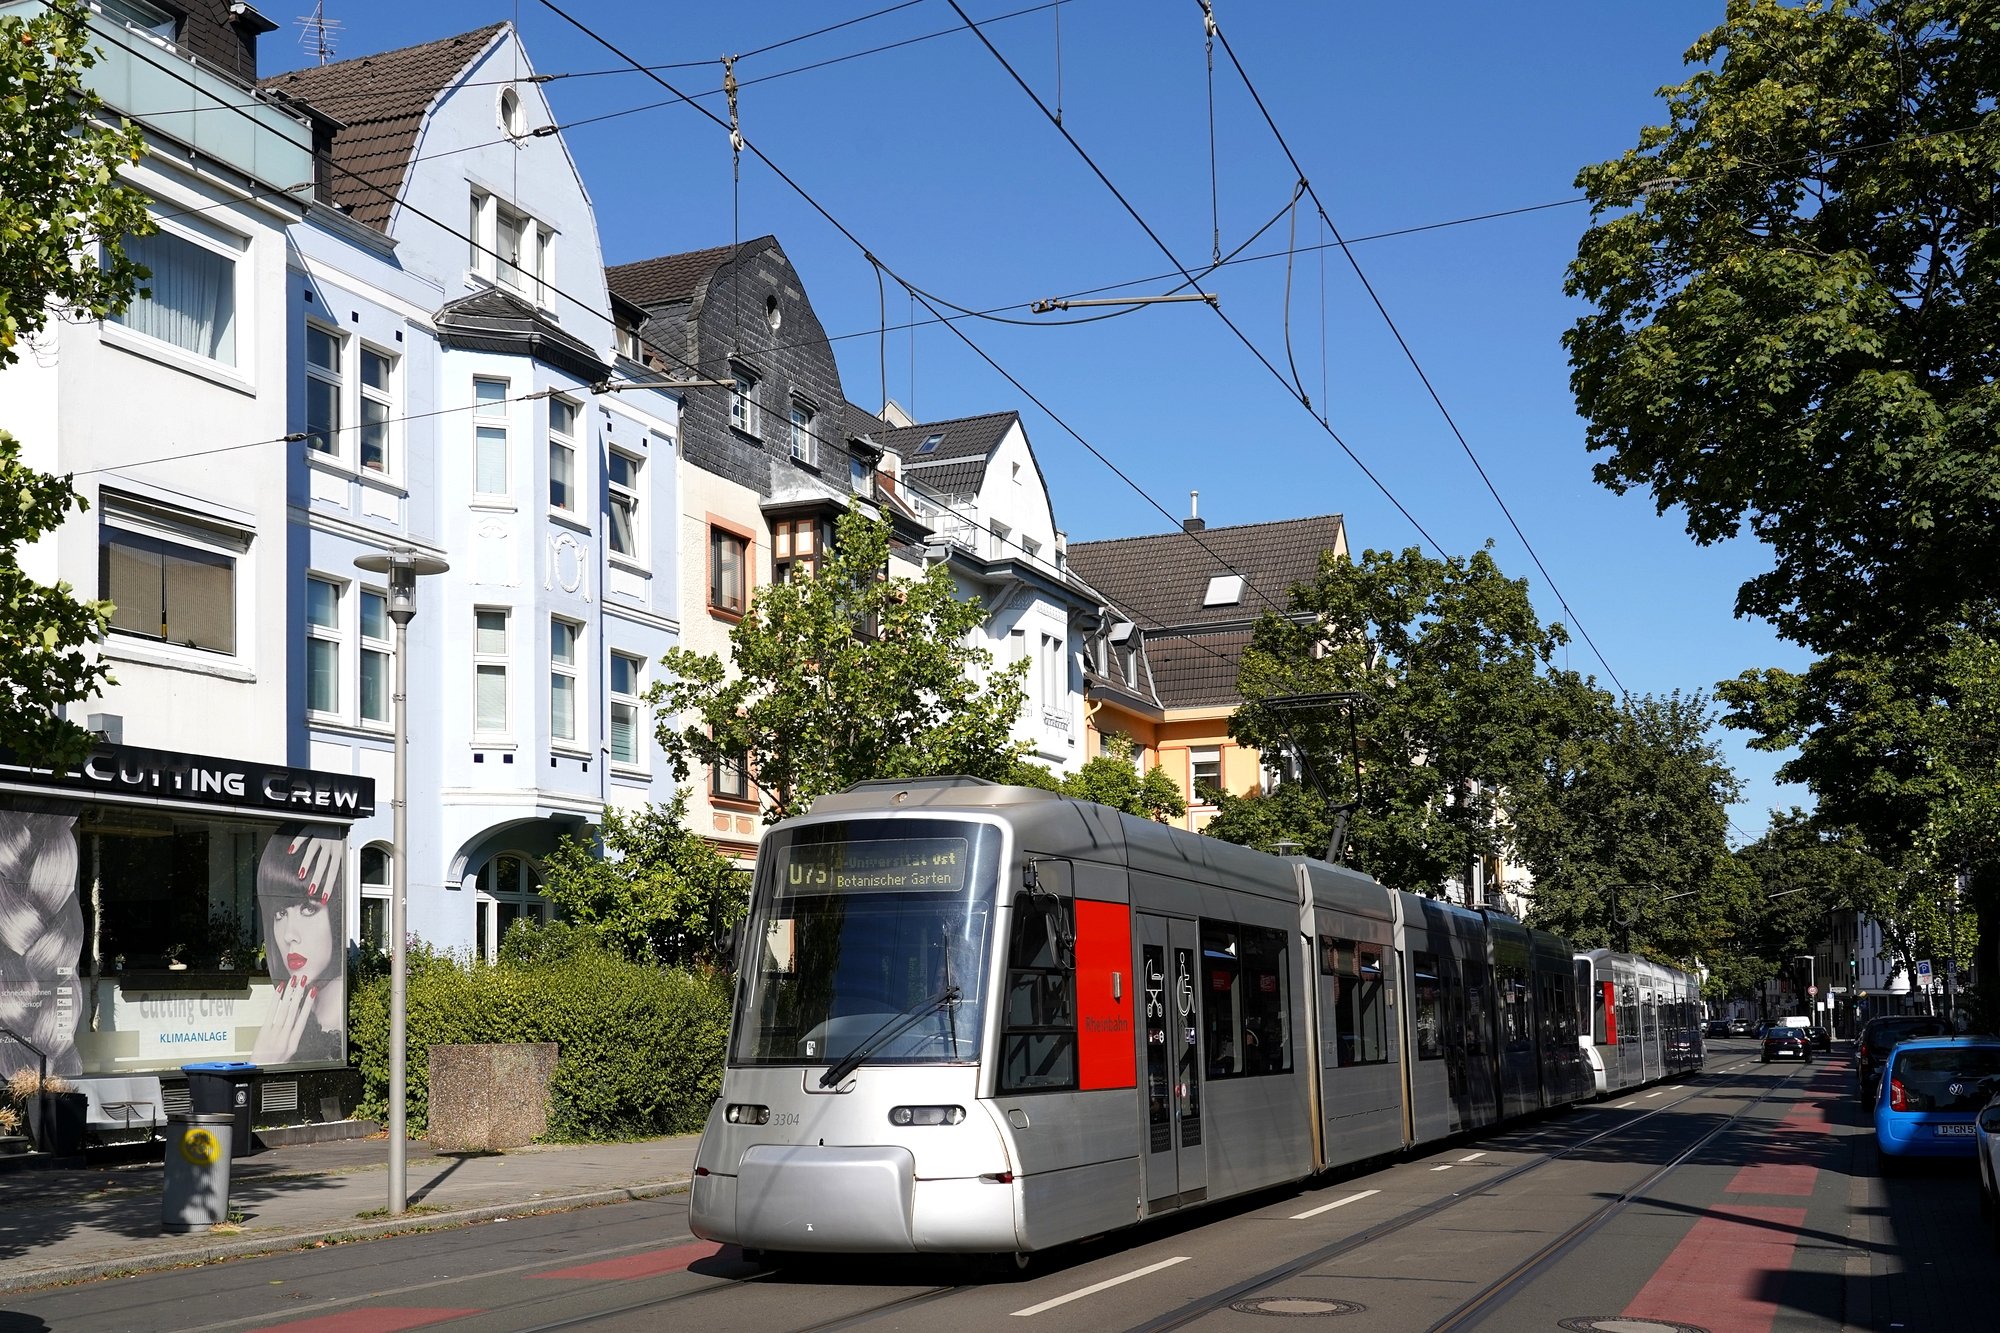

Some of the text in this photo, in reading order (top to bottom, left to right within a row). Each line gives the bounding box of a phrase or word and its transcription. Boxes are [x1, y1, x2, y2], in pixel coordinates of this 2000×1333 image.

[837, 872, 951, 888] Botanischer Garten
[140, 992, 234, 1025] Cutting Crew
[160, 1031, 227, 1043] KLIMAANLAGE
[773, 1113, 799, 1126] 3304
